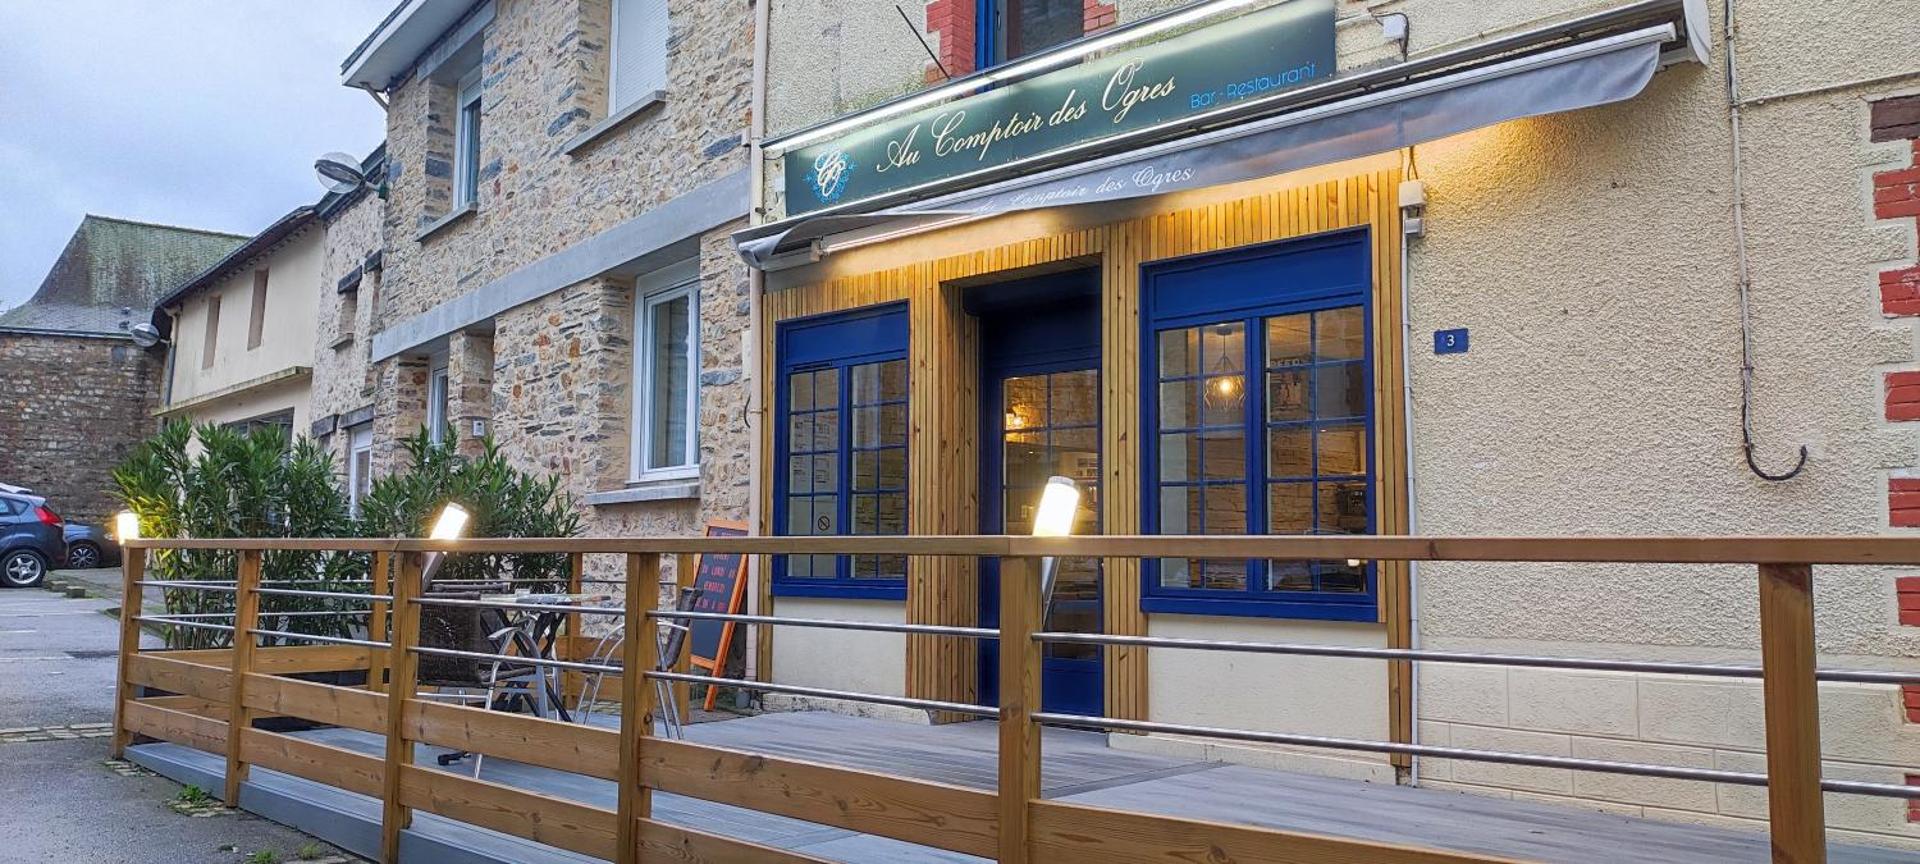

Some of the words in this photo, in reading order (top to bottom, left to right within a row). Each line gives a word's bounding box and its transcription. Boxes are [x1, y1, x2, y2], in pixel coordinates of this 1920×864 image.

[1190, 90, 1217, 110] Bar
[1226, 61, 1316, 99] Restaurant
[876, 124, 921, 173] Au
[931, 110, 1044, 161] Comptoir
[1048, 88, 1088, 127] des
[1102, 56, 1176, 124] Ogres
[1009, 184, 1088, 207] Comptoir
[1095, 176, 1128, 195] des
[1132, 165, 1195, 192] Ogres
[1446, 334, 1456, 347] 3
